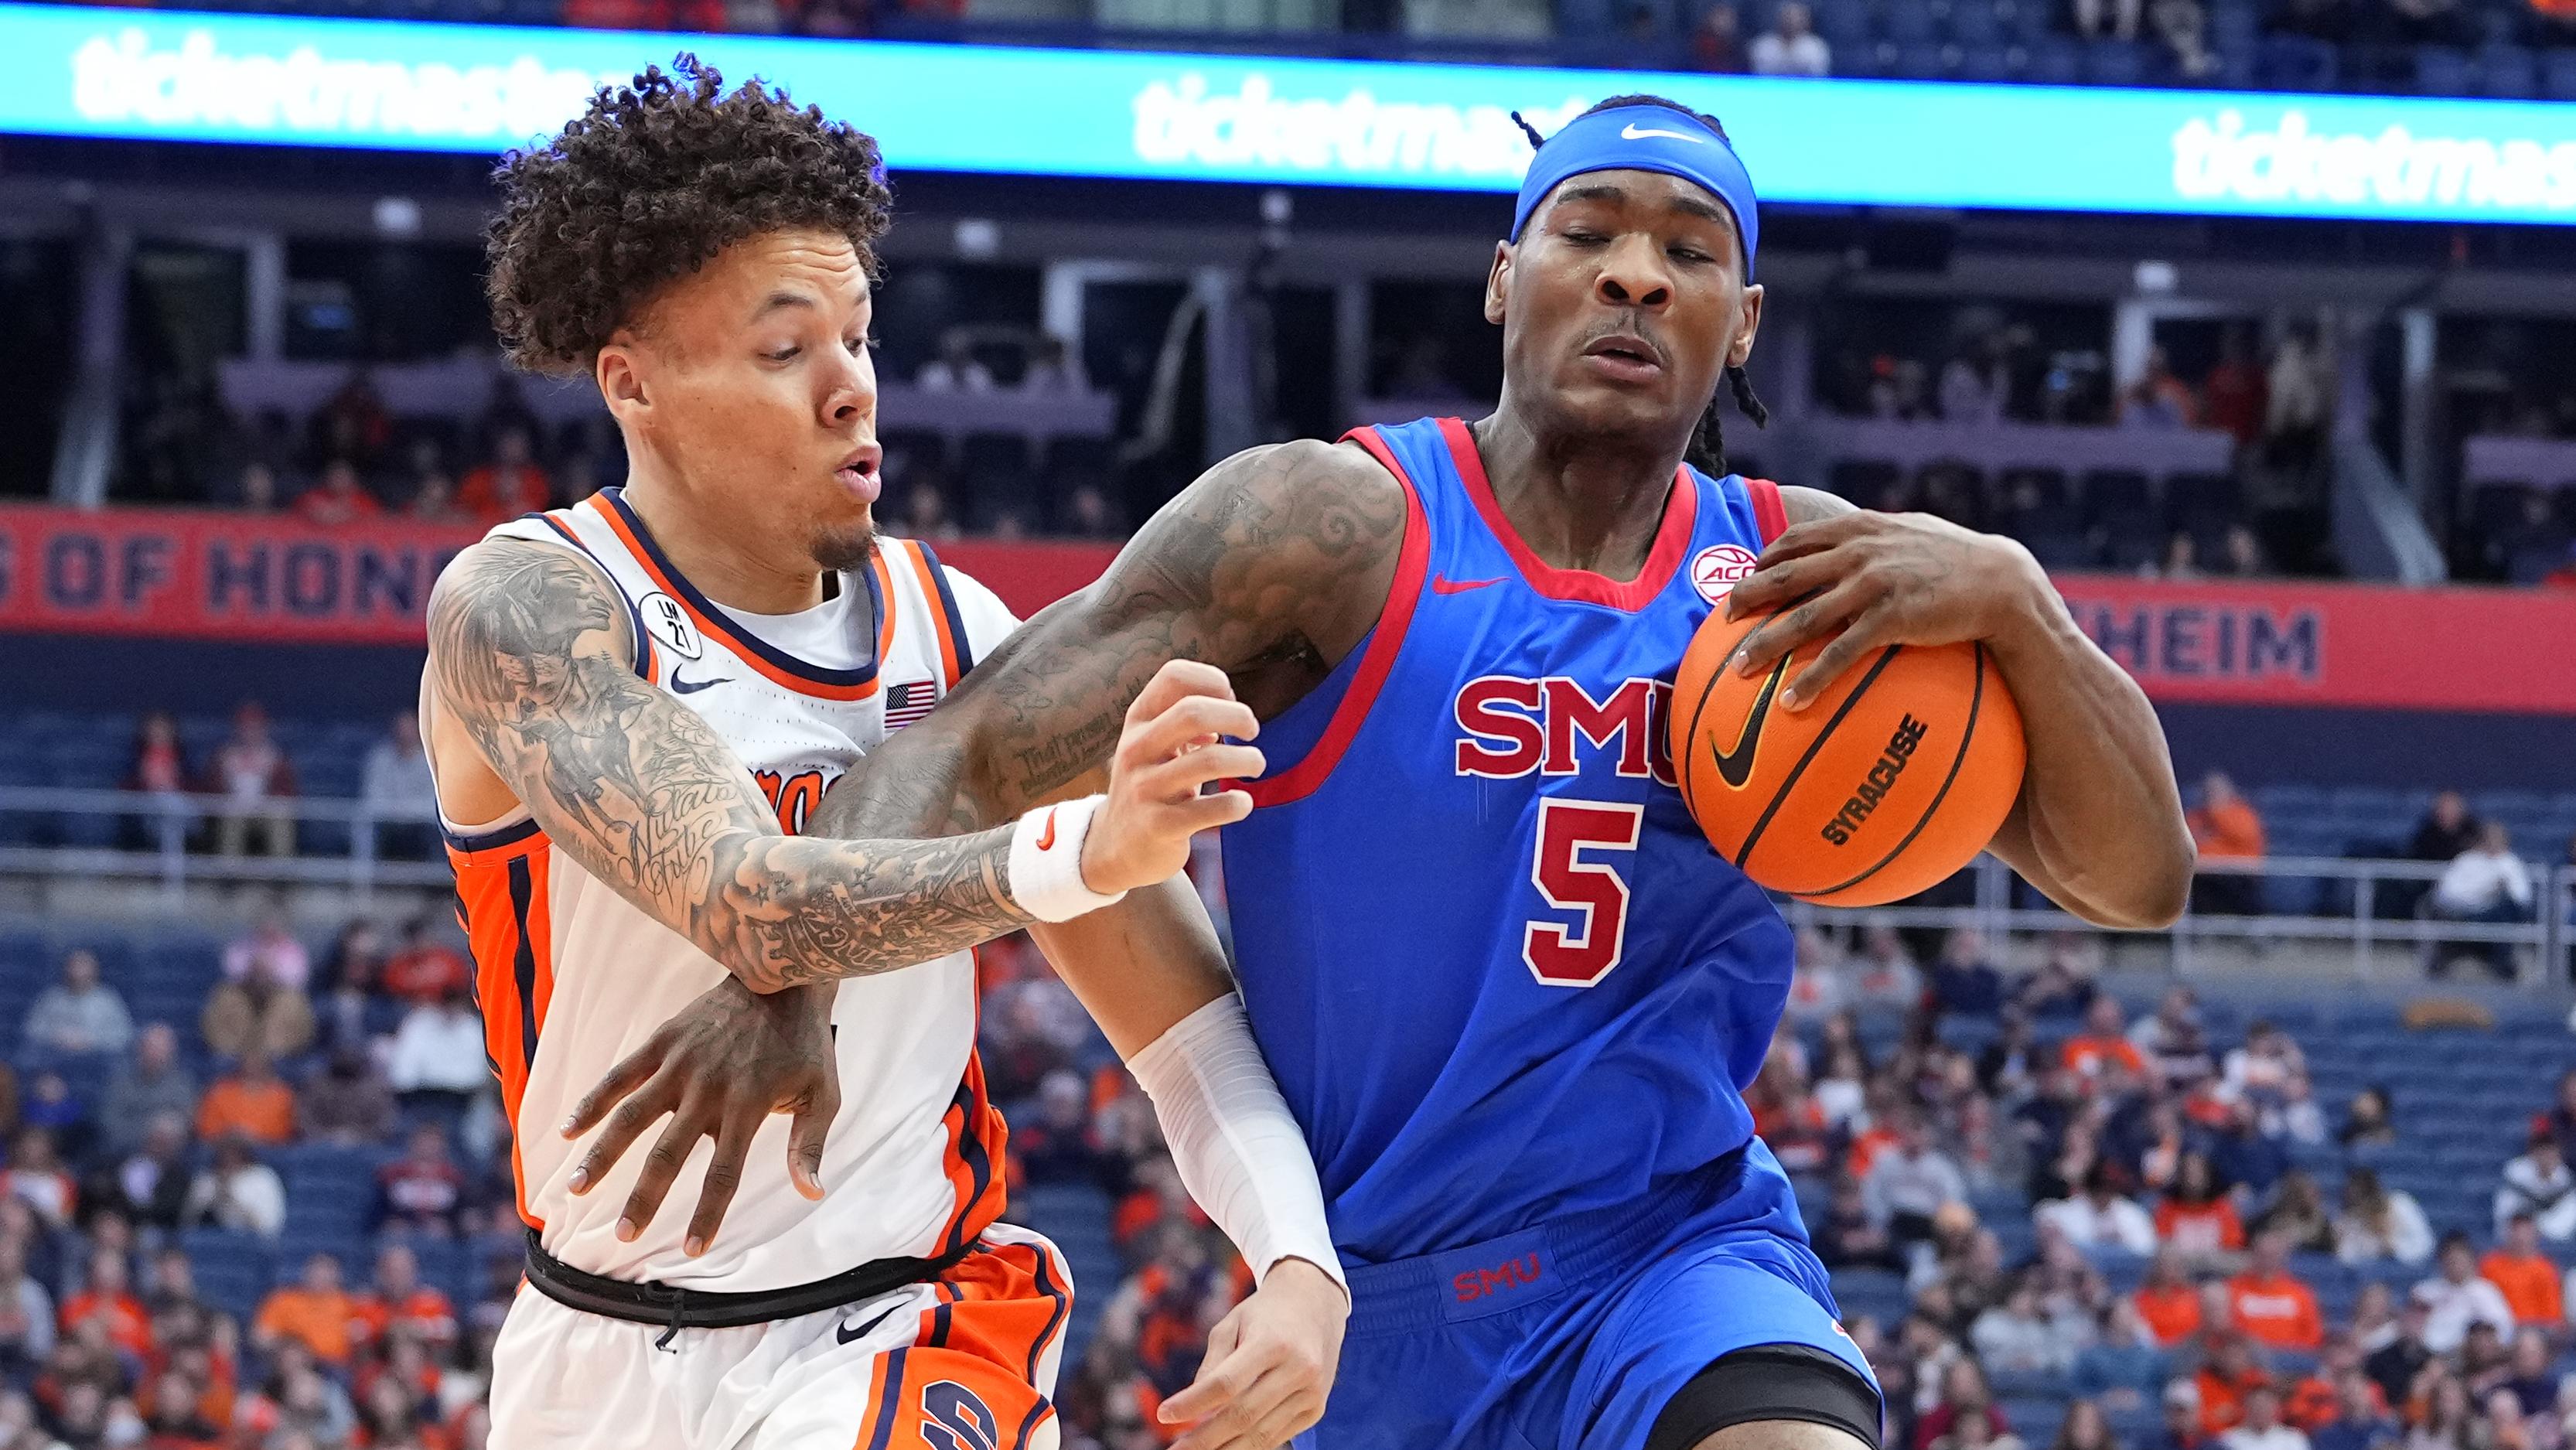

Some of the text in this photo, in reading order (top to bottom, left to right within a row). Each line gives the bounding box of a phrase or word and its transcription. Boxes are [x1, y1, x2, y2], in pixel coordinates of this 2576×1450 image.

[657, 599, 681, 623] LM
[667, 620, 692, 651] 21
[2069, 600, 2326, 685] HEIM
[1820, 711, 1929, 846] SYRACUSE
[1521, 796, 1645, 988] 5
[1452, 1251, 1542, 1303] SMU
